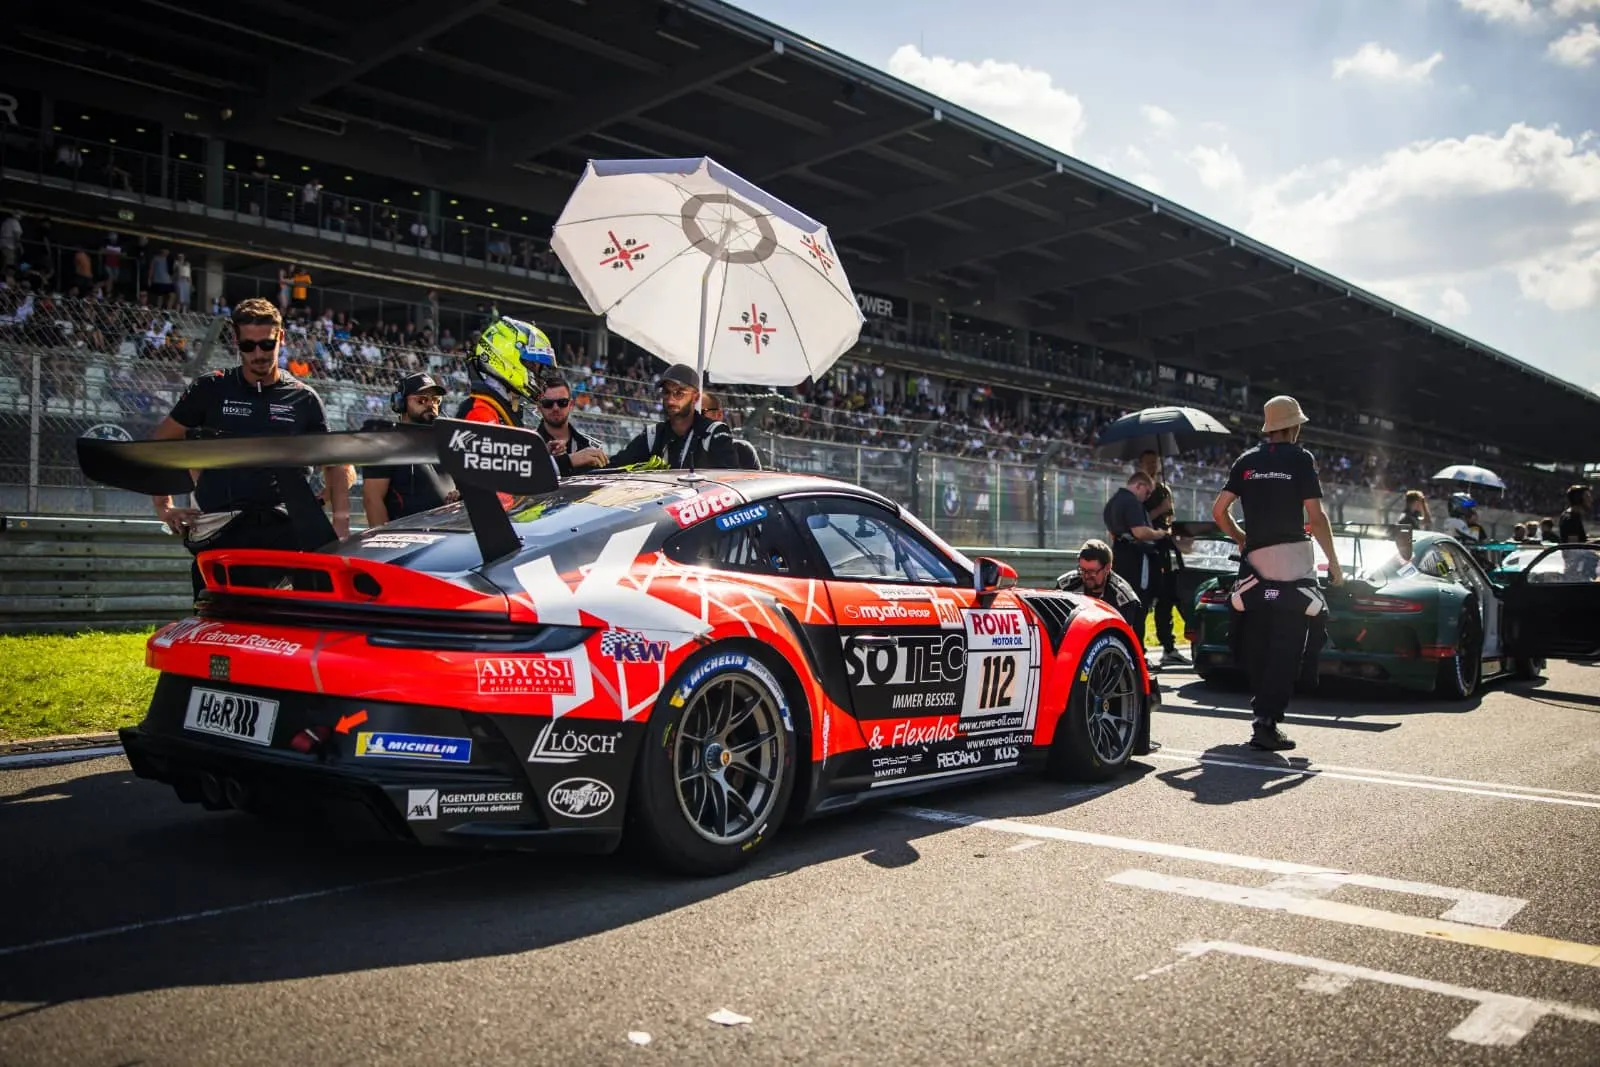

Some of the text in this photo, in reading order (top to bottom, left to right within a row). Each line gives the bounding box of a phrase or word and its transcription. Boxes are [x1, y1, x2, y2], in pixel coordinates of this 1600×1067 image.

[857, 293, 893, 318] OWER
[449, 430, 532, 457] Krämer
[463, 452, 532, 477] Racing
[722, 503, 764, 528] BASTUCK
[970, 612, 1022, 636] ROWE
[244, 633, 302, 656] Racing
[614, 640, 669, 663] KW
[991, 636, 1013, 646] MOTOR
[480, 659, 572, 679] ABYSSI
[690, 655, 744, 686] MICHELIN
[842, 634, 964, 686] SOTEC
[979, 655, 1016, 710] 112
[892, 691, 957, 710] IMMER BESSER.
[959, 714, 1022, 731] www.rowe-oil.com
[387, 741, 458, 754] MICHELIN
[869, 725, 885, 751] &
[966, 732, 1033, 750] www.rowe-oil.com
[874, 767, 907, 779] MANTHEY
[440, 792, 523, 804] AGENTUR DECKER
[442, 806, 469, 814] Service
[490, 804, 520, 812] definiert
[408, 804, 433, 817] AXA
